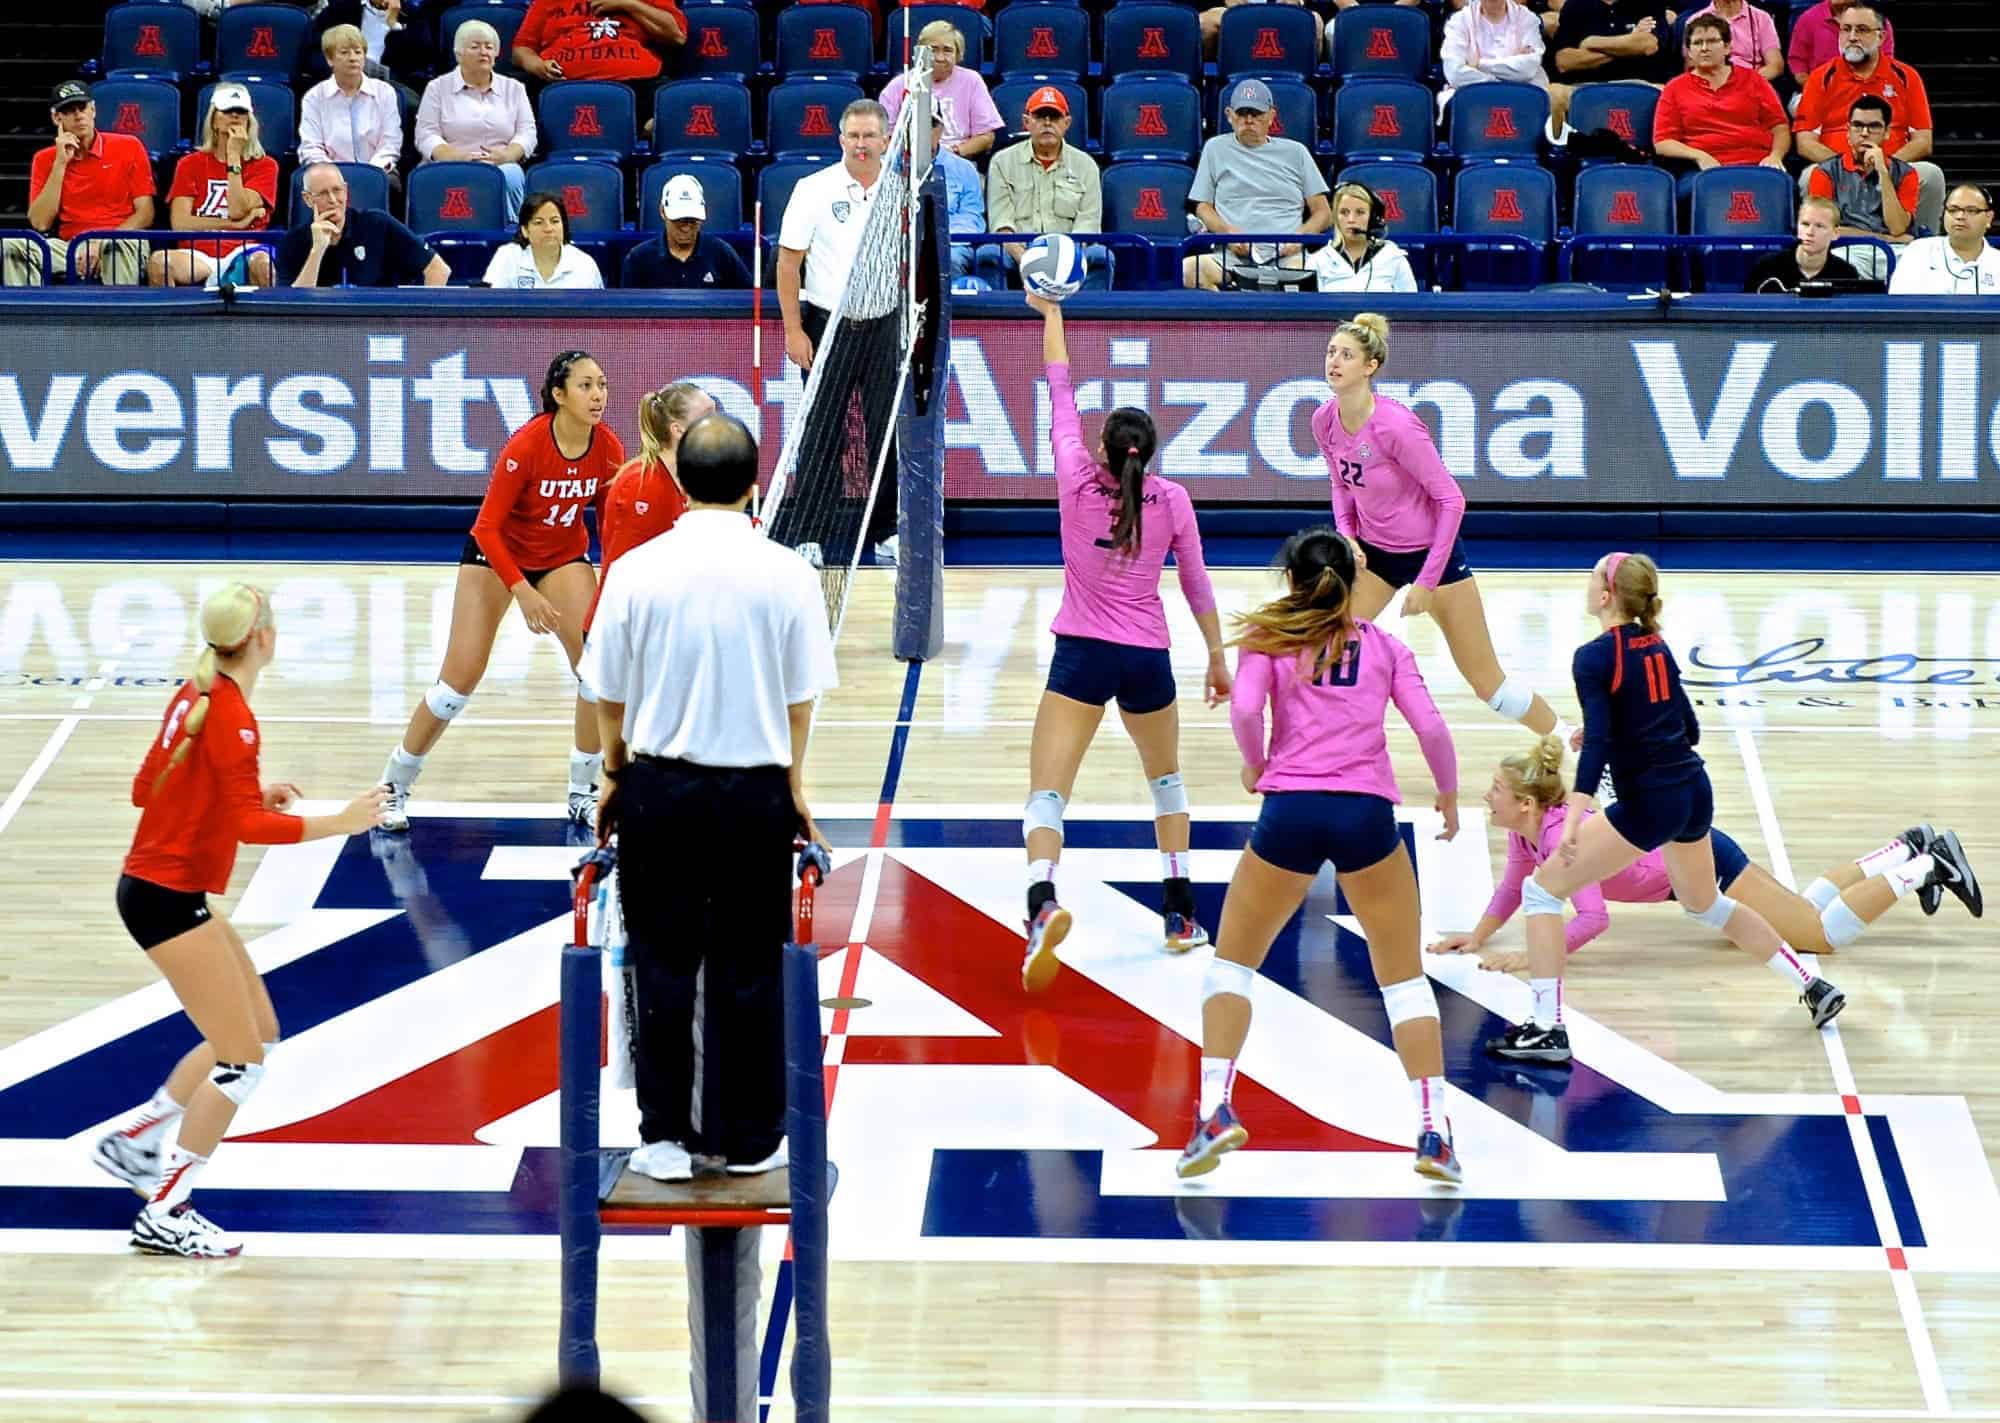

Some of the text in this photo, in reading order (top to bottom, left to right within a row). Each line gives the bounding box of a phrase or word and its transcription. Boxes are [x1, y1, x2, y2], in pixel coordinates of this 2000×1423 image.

[135, 25, 166, 56] A
[247, 28, 278, 57] A
[555, 47, 641, 62] OOTBALL
[699, 28, 728, 57] A
[808, 29, 841, 58] A
[1026, 27, 1060, 58] A
[1137, 27, 1169, 58] A
[1251, 28, 1285, 58] A
[1365, 28, 1398, 59] A
[113, 103, 145, 133] A
[569, 105, 603, 136] A
[685, 105, 719, 136] A
[799, 105, 833, 136] A
[1134, 105, 1169, 136] A
[1368, 106, 1401, 137] A
[1484, 107, 1517, 138] A
[439, 187, 474, 219] A
[1133, 189, 1168, 221] A
[1487, 190, 1523, 222] A
[1607, 191, 1643, 224] A
[1726, 191, 1762, 224] A
[1629, 340, 2000, 482] Voll
[539, 478, 599, 499] UTAH
[1339, 458, 1366, 488] 22
[543, 503, 579, 527] 14
[1312, 640, 1362, 687] 10
[1644, 652, 1671, 704] 11
